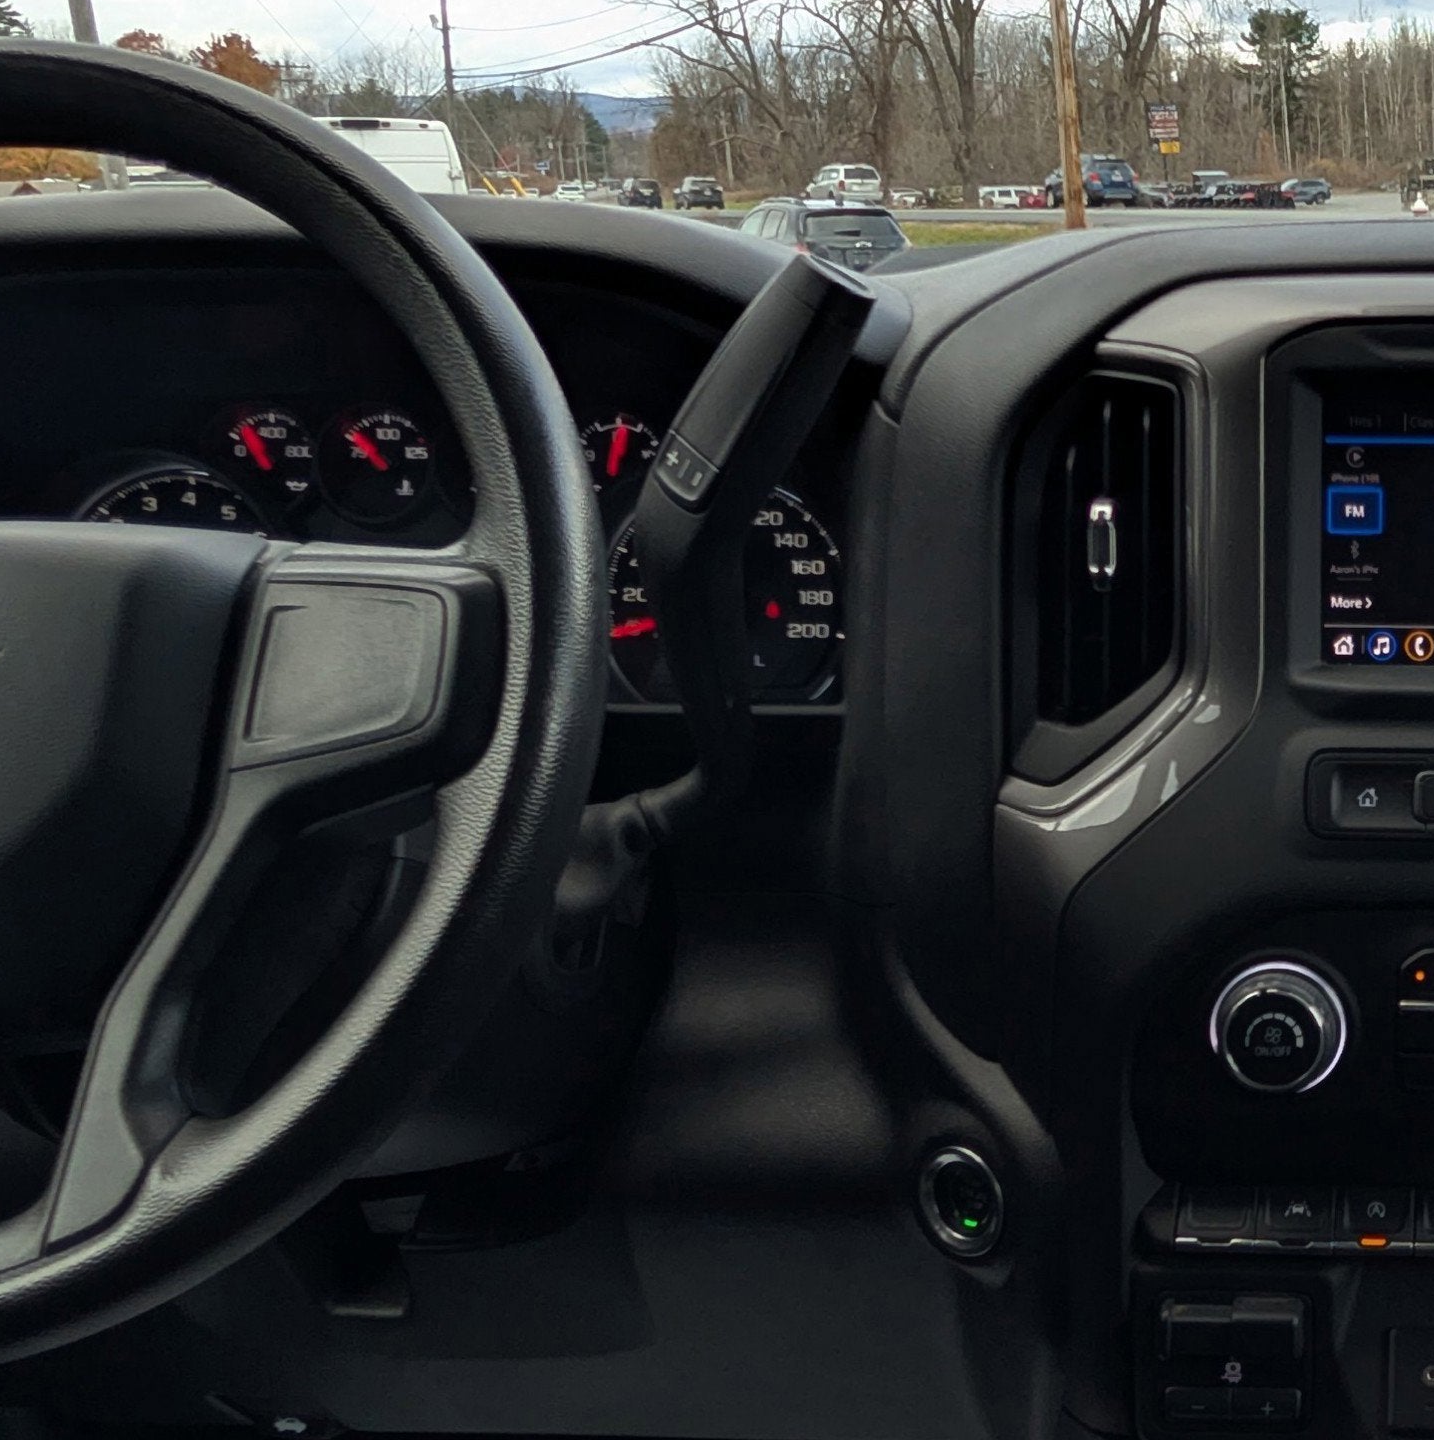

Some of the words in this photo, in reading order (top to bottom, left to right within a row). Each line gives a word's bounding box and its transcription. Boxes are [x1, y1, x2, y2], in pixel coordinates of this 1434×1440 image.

[375, 427, 401, 441] 100
[141, 495, 158, 513] 3
[180, 491, 197, 507] 4
[220, 504, 238, 521] 5
[753, 511, 784, 526] 20
[1345, 504, 1365, 518] FM
[774, 534, 809, 549] 140
[791, 560, 826, 576] 160
[798, 590, 834, 606] 180
[1330, 596, 1363, 609] More
[785, 623, 830, 639] 200
